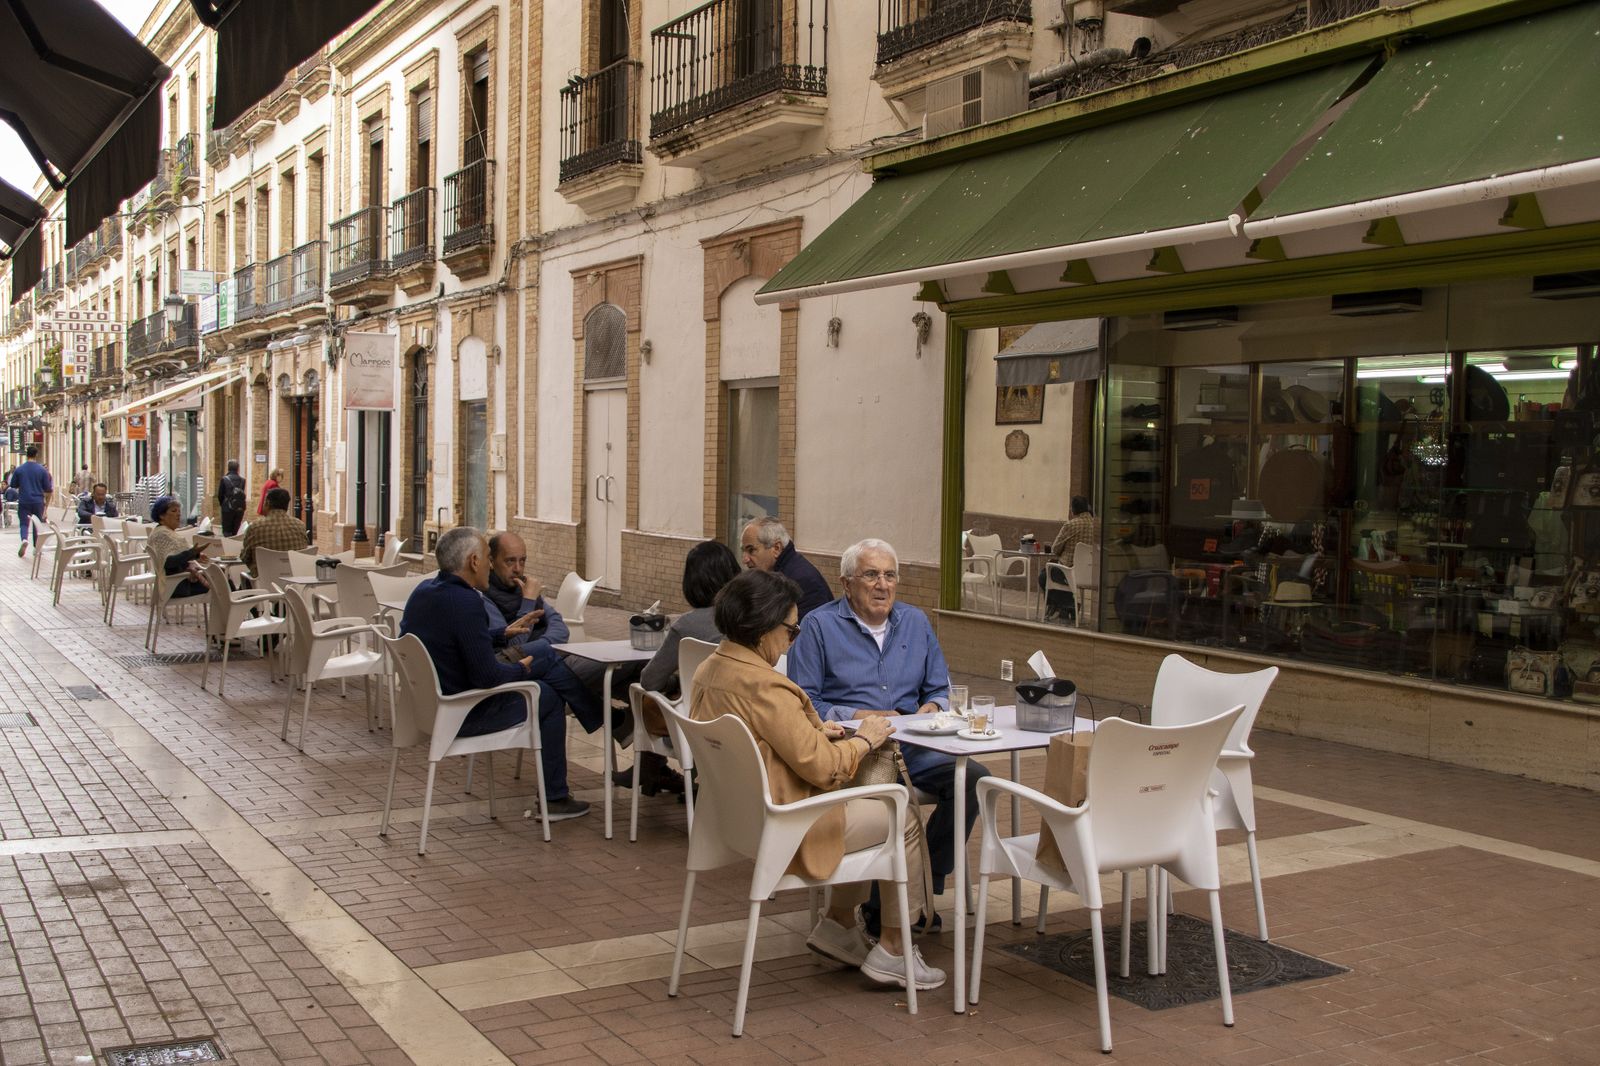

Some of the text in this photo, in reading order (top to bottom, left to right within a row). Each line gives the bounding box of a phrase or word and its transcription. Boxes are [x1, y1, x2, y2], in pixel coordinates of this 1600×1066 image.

[54, 311, 108, 320] FOTO
[40, 321, 122, 332] STUDIO
[76, 334, 88, 384] RODRI
